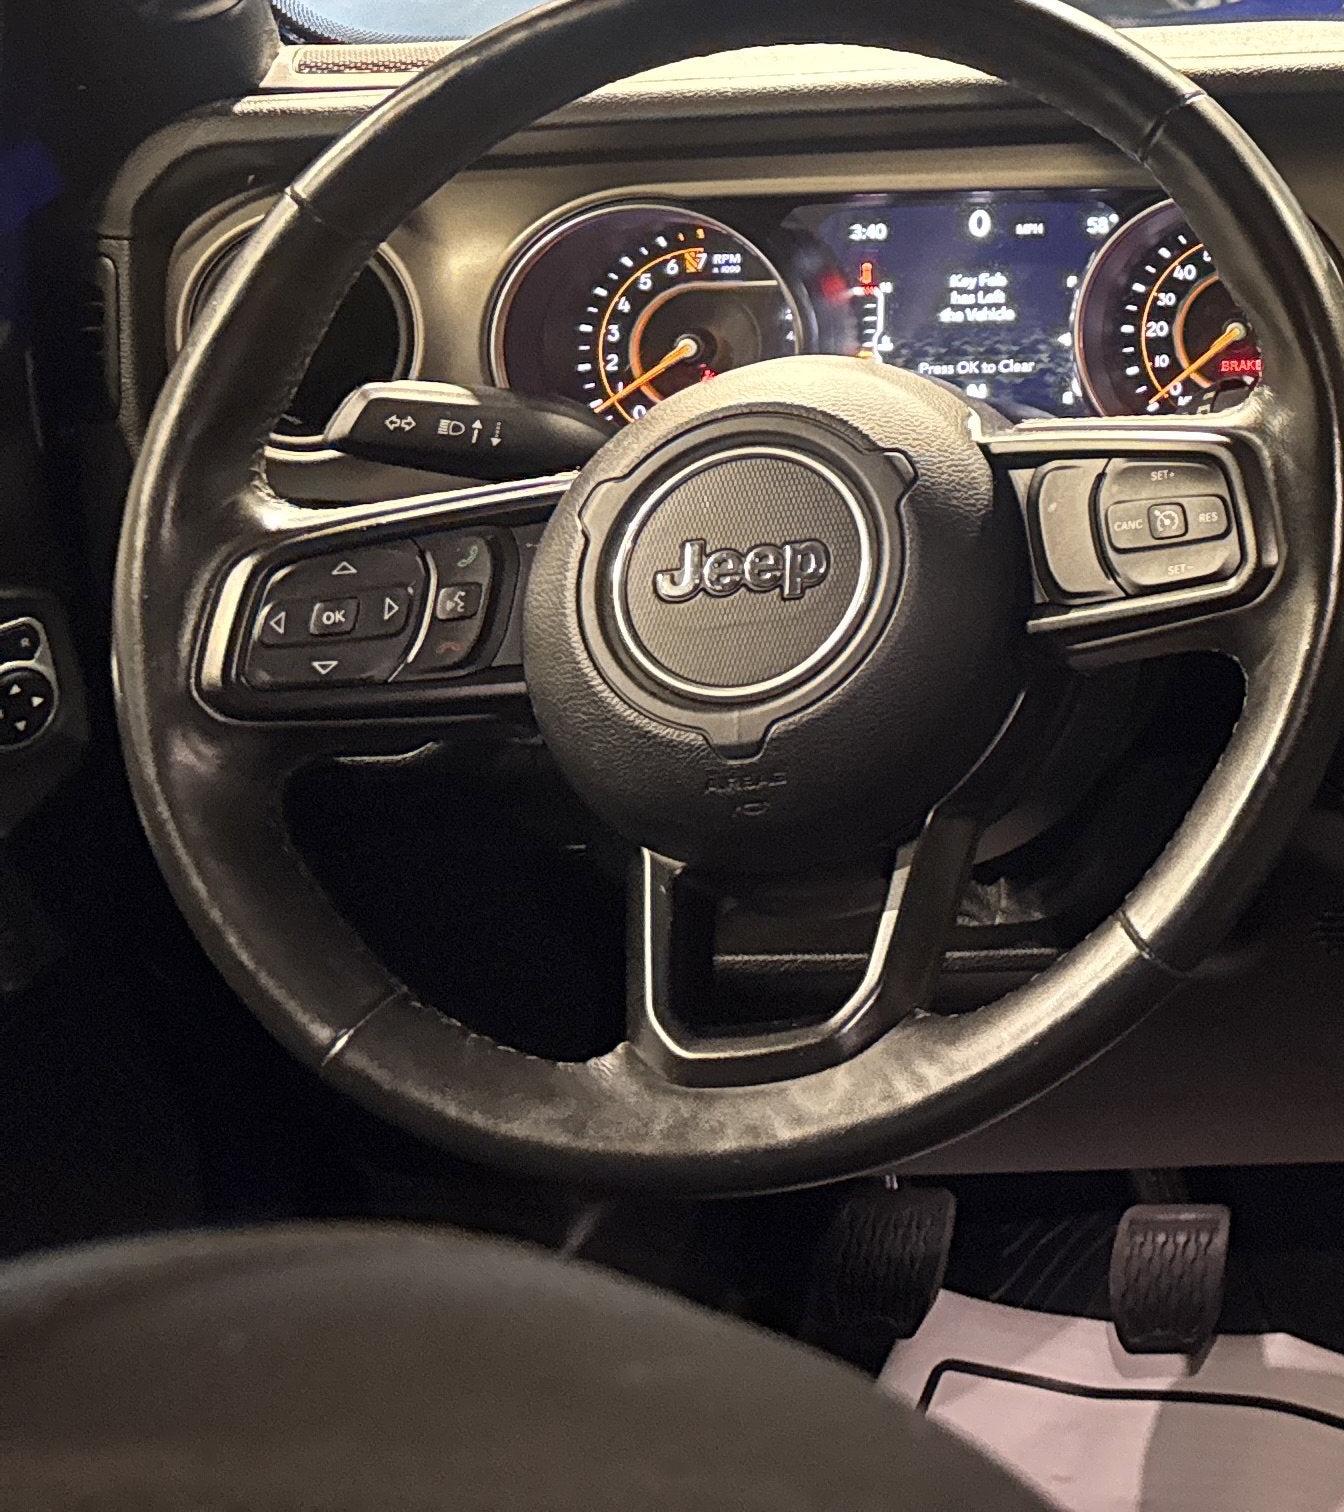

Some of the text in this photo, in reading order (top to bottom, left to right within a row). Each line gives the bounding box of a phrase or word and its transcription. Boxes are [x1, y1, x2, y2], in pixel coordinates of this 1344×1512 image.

[968, 209, 1045, 237] 0 MPH
[848, 222, 888, 241] 3:40
[666, 259, 679, 275] 6
[695, 251, 742, 270] 7 RPM
[1173, 264, 1198, 280] 40
[637, 273, 652, 292] 5
[949, 274, 977, 289] Key
[617, 296, 631, 313] 4
[977, 290, 1006, 305] Left
[1156, 293, 1177, 306] 30
[965, 307, 1017, 322] Vehicle
[607, 325, 621, 342] 3
[1145, 321, 1169, 338] 20
[606, 354, 619, 372] 2
[918, 358, 1035, 375] Press OK to Clear
[1154, 353, 1170, 368] 10
[1220, 359, 1263, 373] BRAKE
[1114, 518, 1144, 532] CANC
[1198, 511, 1219, 523] RES
[653, 538, 831, 604] Jeep
[322, 609, 346, 625] OK
